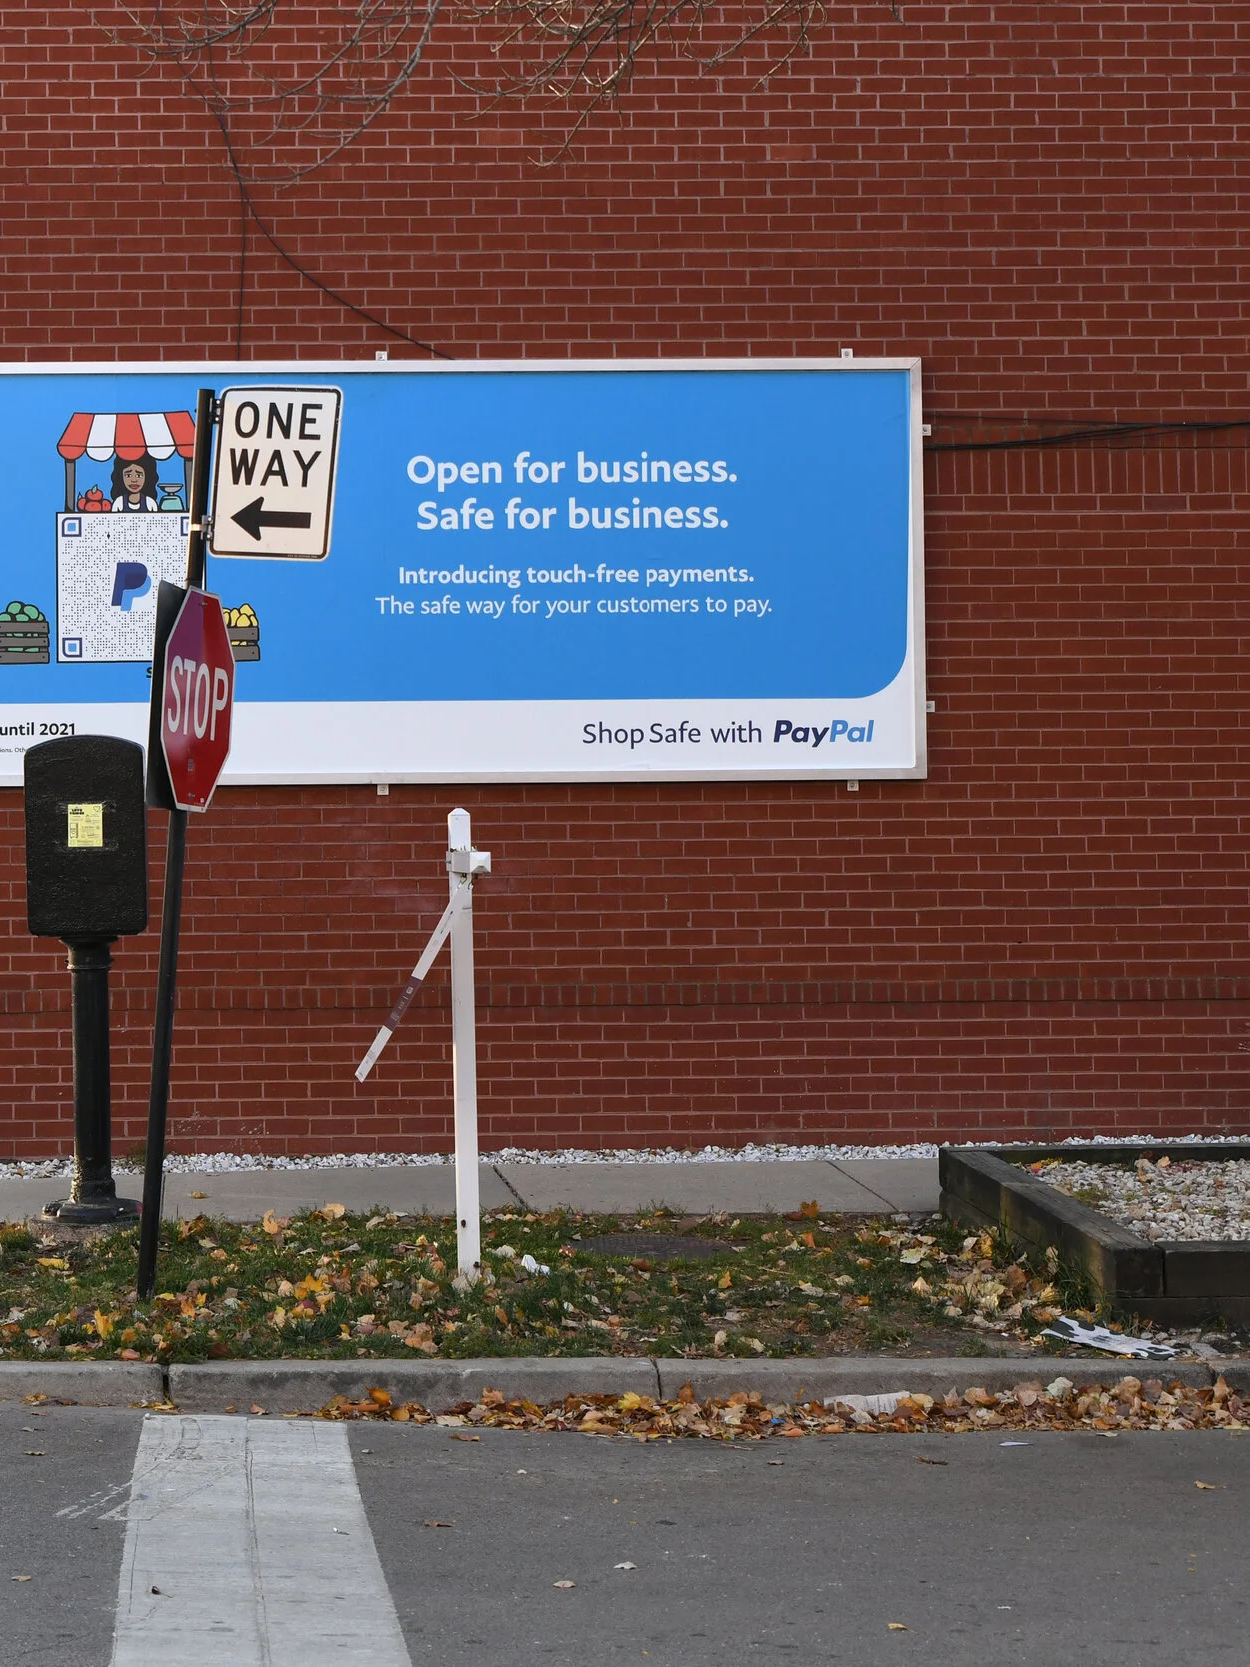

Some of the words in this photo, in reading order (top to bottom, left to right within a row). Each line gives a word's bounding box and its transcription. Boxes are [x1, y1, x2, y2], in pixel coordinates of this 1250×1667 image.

[234, 401, 324, 442] ONE
[229, 448, 322, 488] WAY
[406, 455, 503, 492] Open
[514, 451, 566, 484] for
[576, 451, 739, 484] business.
[416, 498, 494, 531] Safe
[505, 498, 557, 530] for
[568, 497, 730, 530] business.
[398, 565, 521, 588] Introducing
[526, 564, 640, 584] touch-free
[646, 566, 755, 588] payments.
[375, 596, 415, 616] The
[420, 595, 462, 616] safe
[465, 600, 506, 619] way
[511, 594, 541, 615] for
[545, 599, 592, 619] your
[597, 596, 700, 614] customers
[705, 596, 728, 614] to
[734, 597, 773, 617] pay.
[167, 655, 229, 741] STOP
[0, 722, 35, 736] until
[39, 723, 76, 736] 2021
[582, 721, 645, 751] Shop
[650, 721, 701, 744] Safe
[710, 720, 762, 744] with
[773, 719, 874, 748] PayPal
